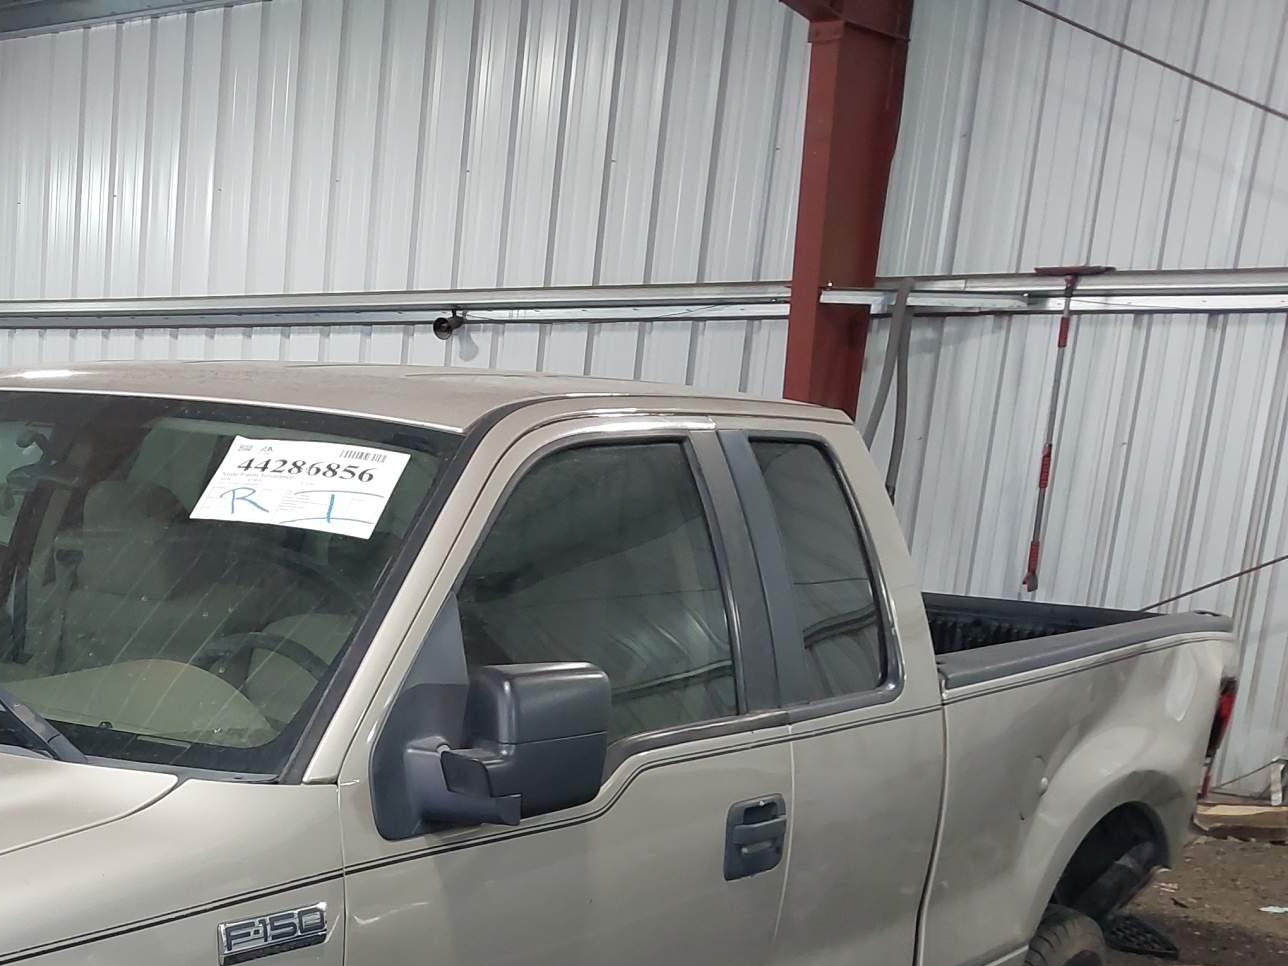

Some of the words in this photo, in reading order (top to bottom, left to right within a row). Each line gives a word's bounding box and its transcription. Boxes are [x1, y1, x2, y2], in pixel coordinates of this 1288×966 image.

[237, 457, 377, 483] 44286856
[219, 486, 270, 514] R
[224, 906, 326, 951] F-150
